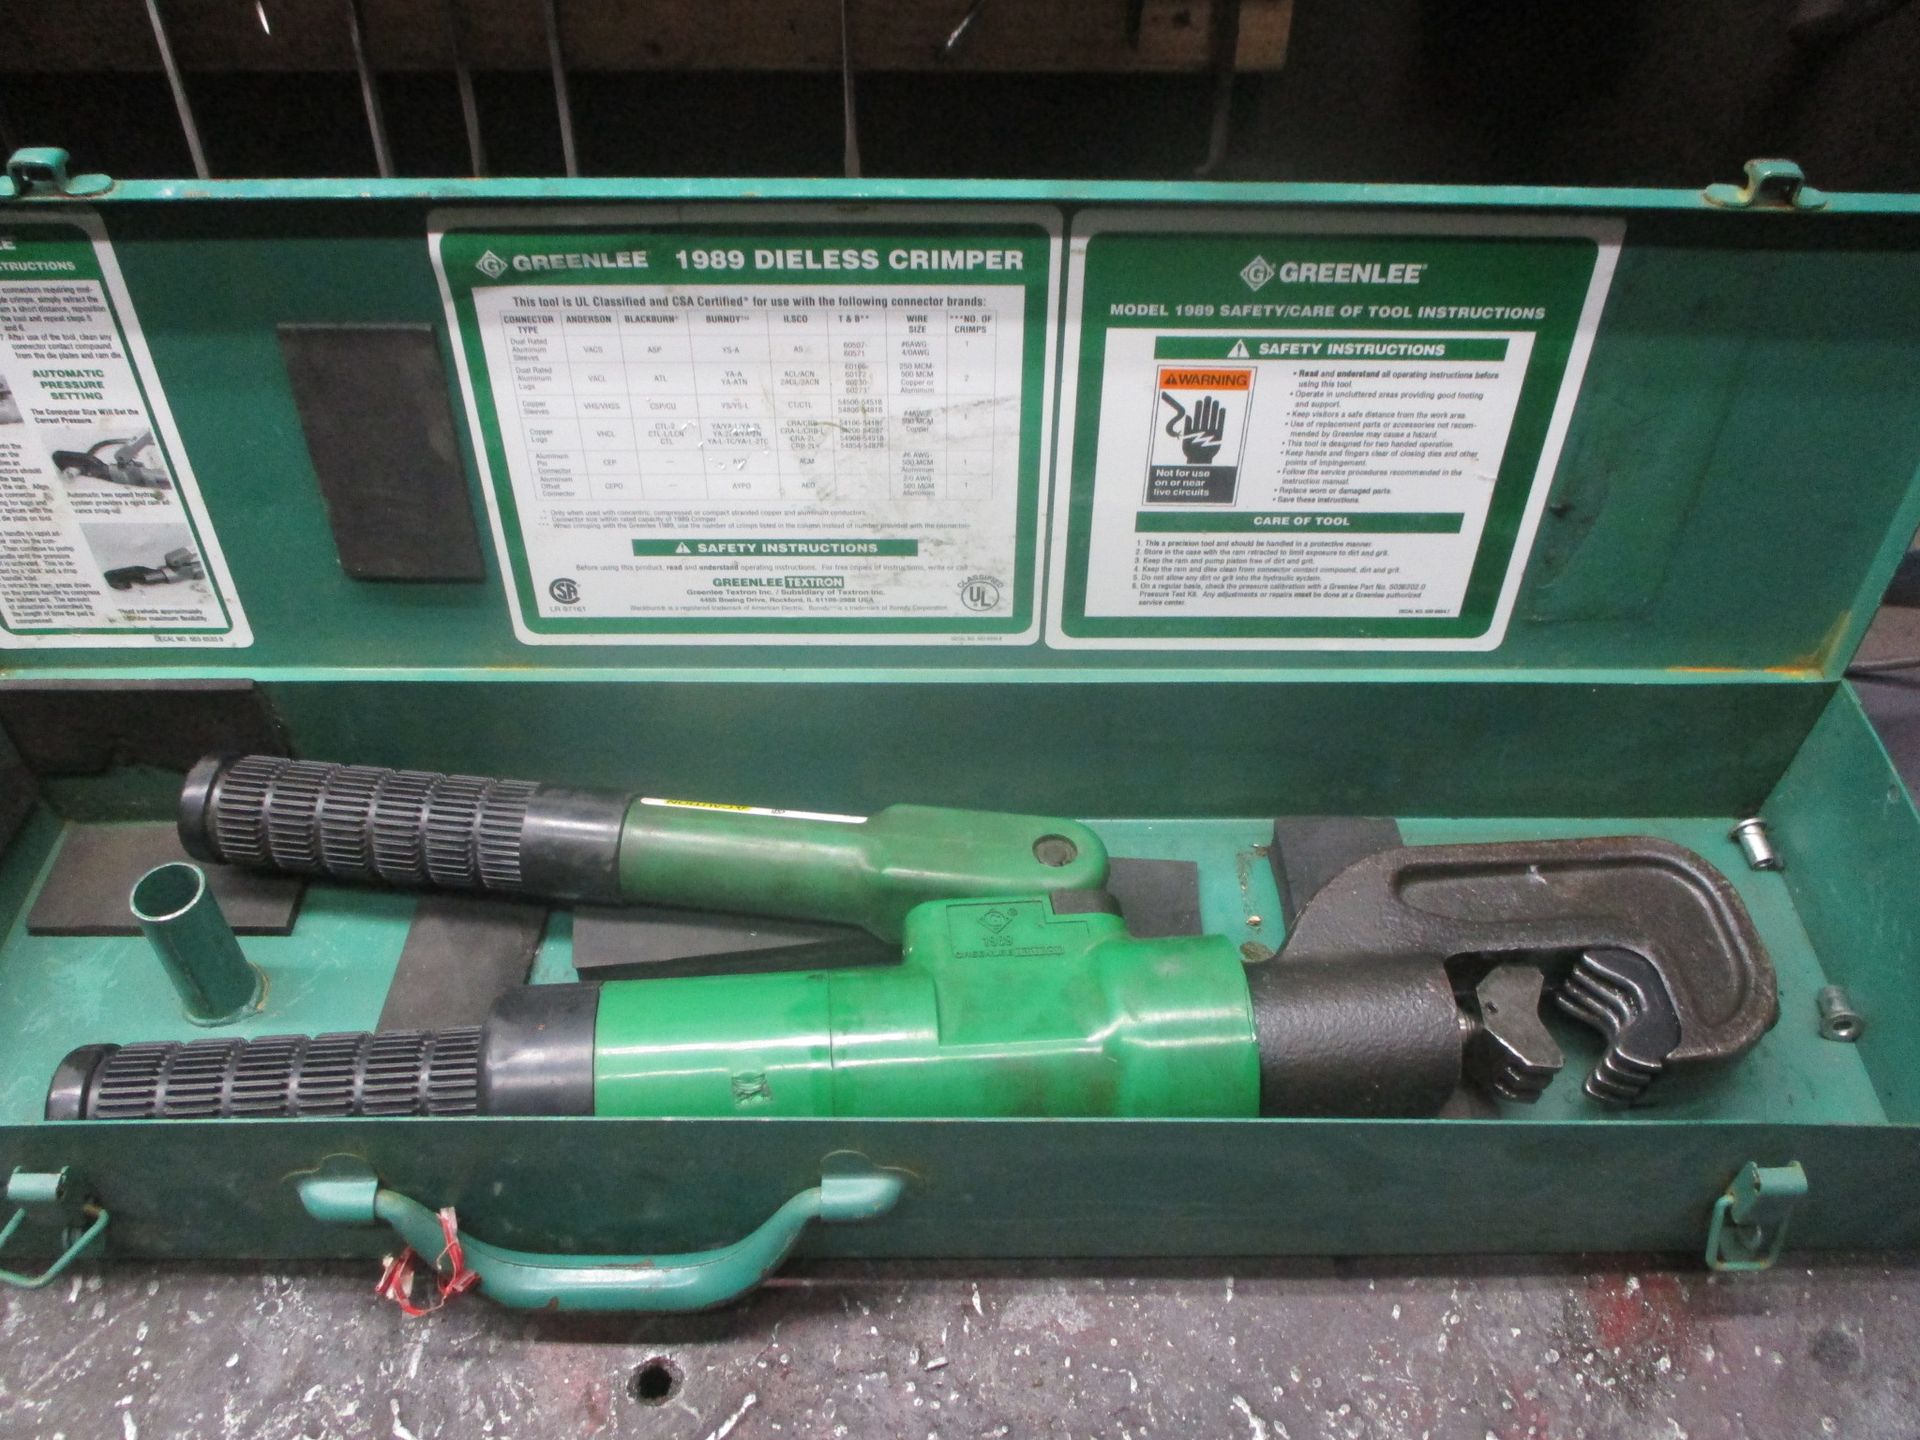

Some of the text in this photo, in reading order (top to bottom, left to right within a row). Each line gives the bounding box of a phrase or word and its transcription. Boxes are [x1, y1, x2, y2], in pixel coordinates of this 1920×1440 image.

[512, 250, 1024, 272] GREENLEE 1989 DIELESS CRIMPER
[1279, 262, 1421, 284] GREENLEE
[513, 296, 536, 307] This
[540, 296, 558, 307] tool
[562, 296, 572, 307] is
[574, 296, 590, 307] UL
[593, 296, 646, 307] Classified
[649, 296, 668, 307] and
[672, 296, 694, 307] CSA
[752, 296, 768, 307] for
[771, 299, 790, 307] use
[794, 296, 815, 307] with
[818, 296, 836, 307] the
[838, 296, 888, 308] following
[891, 296, 944, 307] connector
[946, 296, 987, 307] brands:
[1110, 304, 1546, 320] MODEL 1989 SAFETY/CARE OF TOOL INSTRUCTIONS
[503, 315, 554, 324] CONNECTOR
[566, 315, 612, 324] ANDERSON
[783, 315, 808, 323] ILSCO
[906, 315, 928, 323] WIRE
[981, 315, 992, 323] OF
[518, 326, 538, 334] TYPE
[908, 326, 926, 334] SIZE
[954, 326, 987, 334] CRIMPS
[1259, 343, 1446, 355] SAFETY INSTRUCTIONS
[32, 370, 104, 378] AUTOMATIC
[1300, 370, 1498, 380] Read and understand all operating instructions before
[1178, 374, 1248, 386] WARNING
[1299, 380, 1319, 388] using
[1295, 390, 1324, 400] Operate
[1326, 390, 1333, 398] in
[1335, 390, 1377, 398] uncluttered
[1400, 390, 1435, 400] providing
[1437, 391, 1456, 400] good
[1458, 391, 1484, 400] footing
[1292, 411, 1310, 419] Keep
[1156, 469, 1173, 478] Not
[1176, 469, 1190, 478] for
[1153, 488, 1210, 496] live circuits
[1254, 516, 1350, 526] CARE OF TOOL
[698, 544, 878, 552] SAFETY INSTRUCTIONS
[712, 578, 842, 587] GREENLEE TEXTRON
[957, 574, 1004, 588] CLASSIFIED
[970, 586, 992, 606] UL
